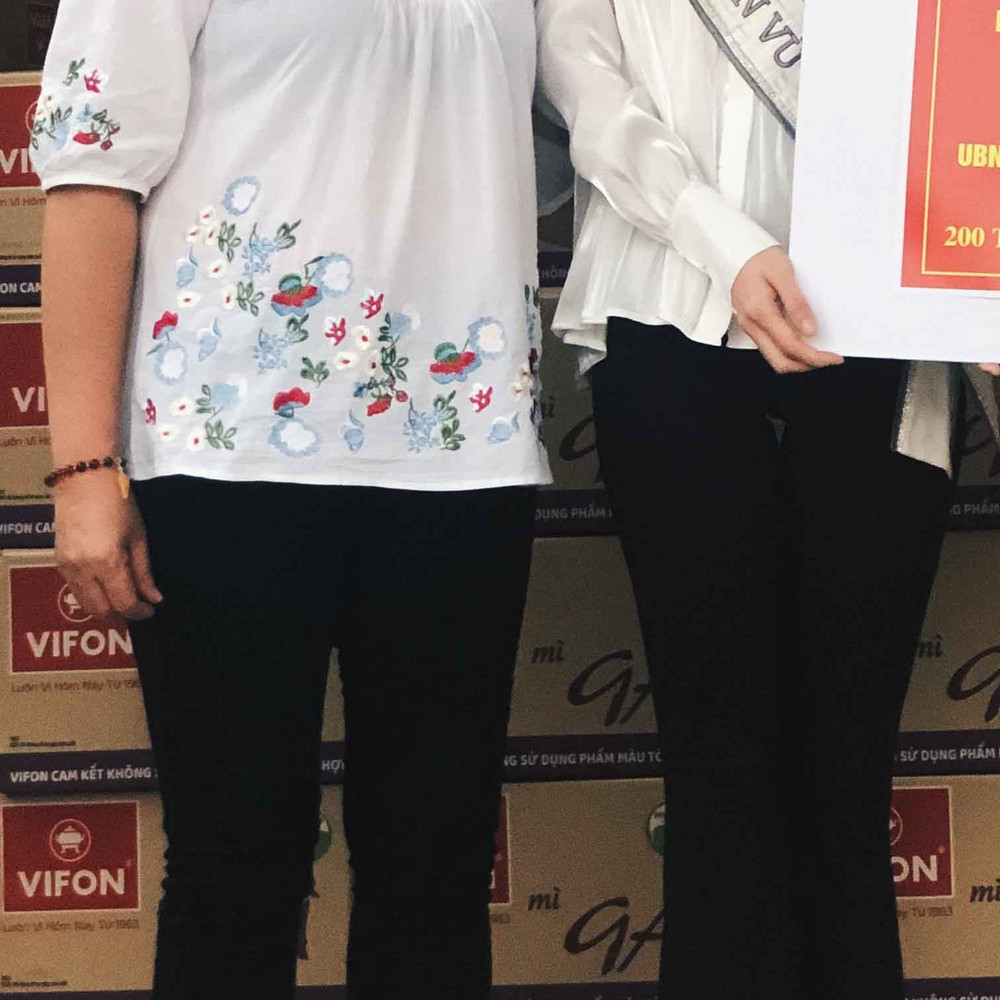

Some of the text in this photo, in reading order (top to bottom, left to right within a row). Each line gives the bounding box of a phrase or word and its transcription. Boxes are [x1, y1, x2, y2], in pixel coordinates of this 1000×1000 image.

[0, 149, 31, 174] VI
[944, 226, 985, 248] 200
[964, 499, 1000, 515] PHẨM
[26, 629, 133, 658] VIFON
[531, 640, 564, 663] mì
[520, 751, 537, 767] SỬ
[541, 752, 577, 768] DỤNG
[579, 747, 614, 764] PHẨM
[618, 748, 645, 763] MÀU
[900, 749, 917, 763] SỬ
[921, 748, 956, 764] DỤNG
[960, 742, 995, 759] PHẨM
[10, 763, 152, 783] VIFON CAM KẾT KHÔNG
[17, 868, 125, 897] VIFON
[528, 887, 560, 911] mì
